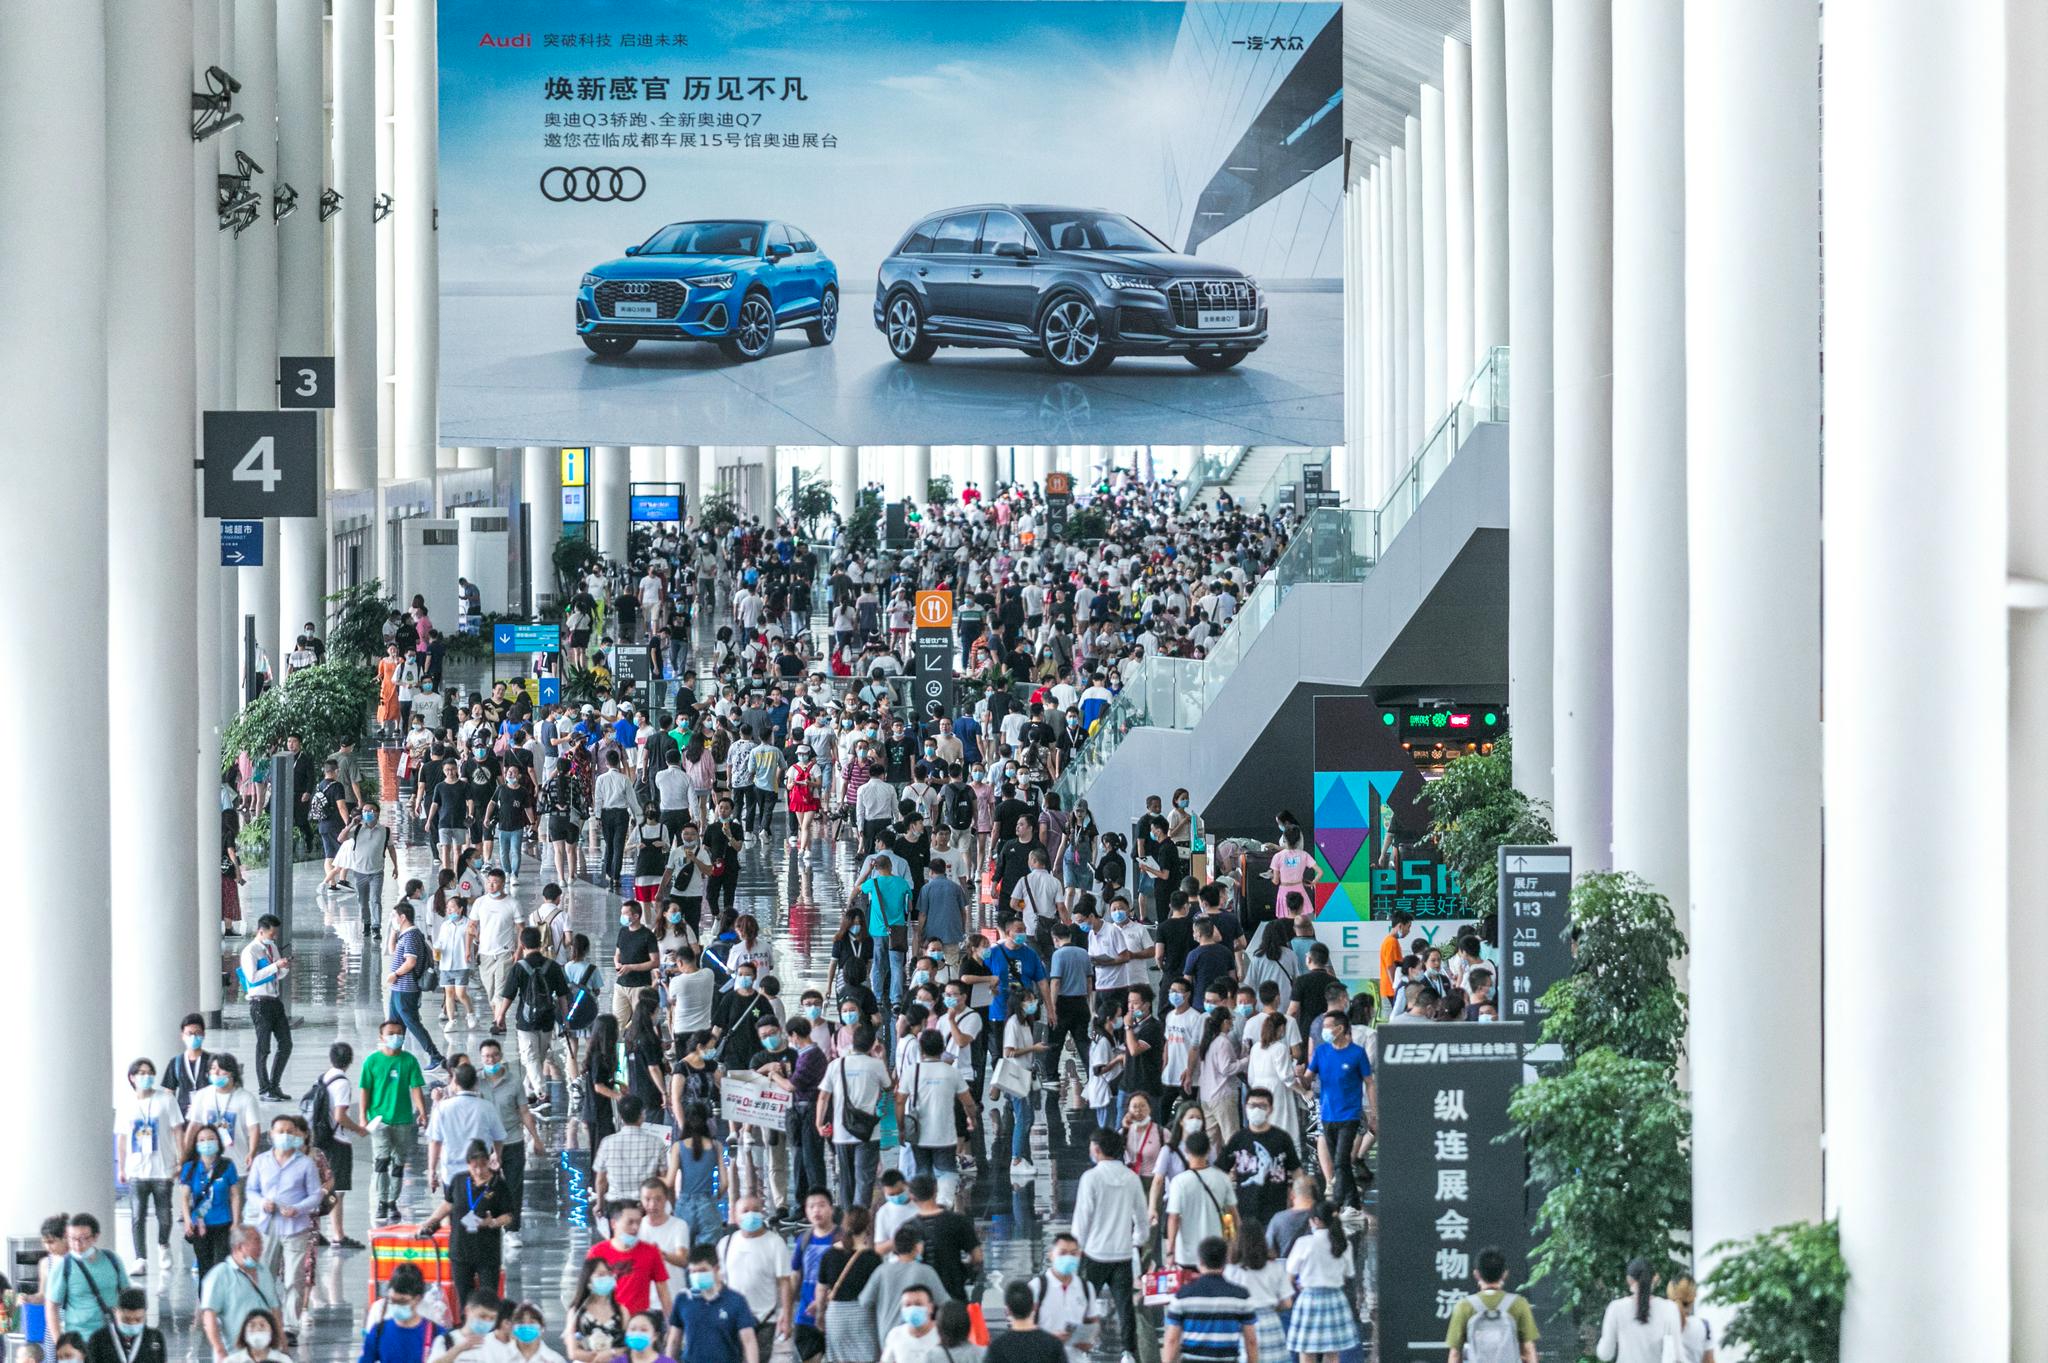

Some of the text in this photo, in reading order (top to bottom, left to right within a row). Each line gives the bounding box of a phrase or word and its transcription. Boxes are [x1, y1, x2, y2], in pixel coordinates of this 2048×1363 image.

[478, 33, 531, 48] Audi
[543, 33, 689, 48] 突破科技 启迪未来
[544, 76, 809, 101] 焕新感官 历见不凡
[544, 112, 762, 128] 奥迪Q3轿跑、全新奥迪Q7
[544, 132, 838, 149] 邀您莅临成都车展15号馆奥迪展台
[295, 368, 318, 397] 3
[232, 436, 282, 492] 4
[1513, 877, 1538, 889] 展厅
[1513, 927, 1537, 939] 入口
[1513, 951, 1525, 966] B
